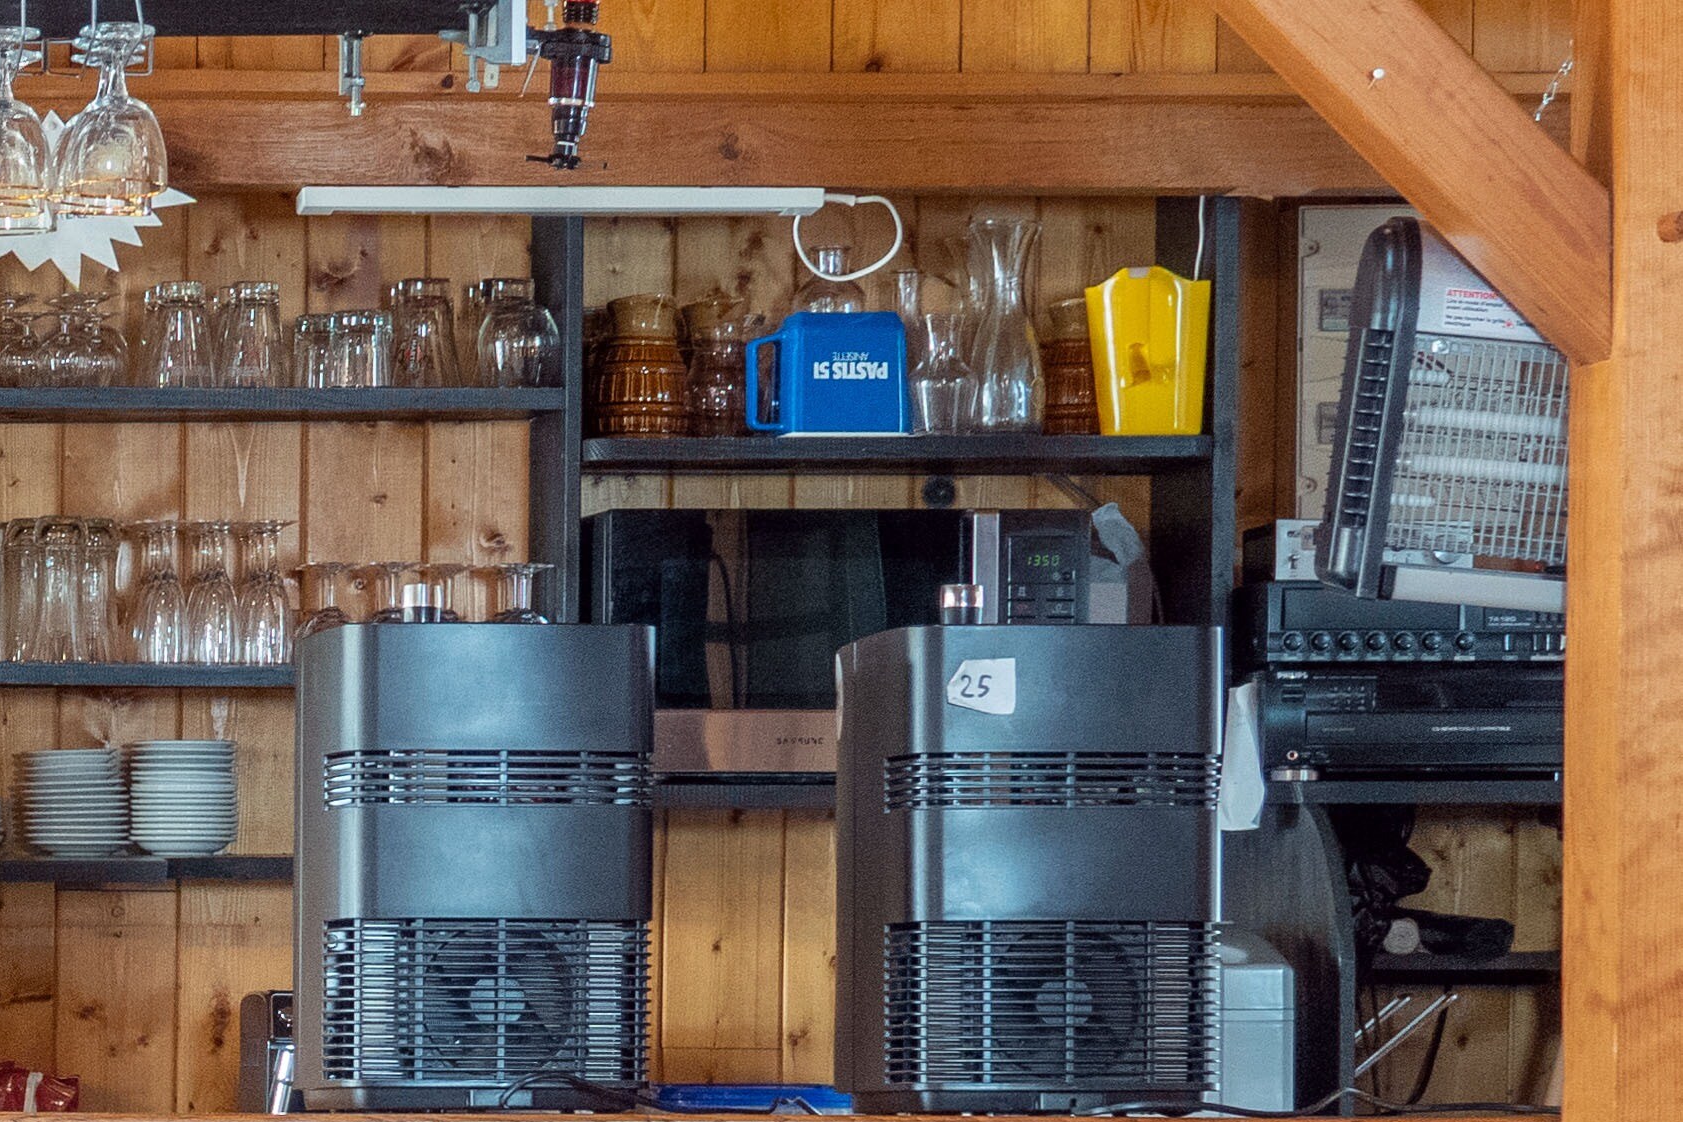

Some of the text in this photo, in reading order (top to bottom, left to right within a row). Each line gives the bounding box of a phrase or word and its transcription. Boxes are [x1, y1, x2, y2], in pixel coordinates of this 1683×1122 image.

[813, 362, 888, 379] PASTIS 51
[960, 674, 992, 698] 25
